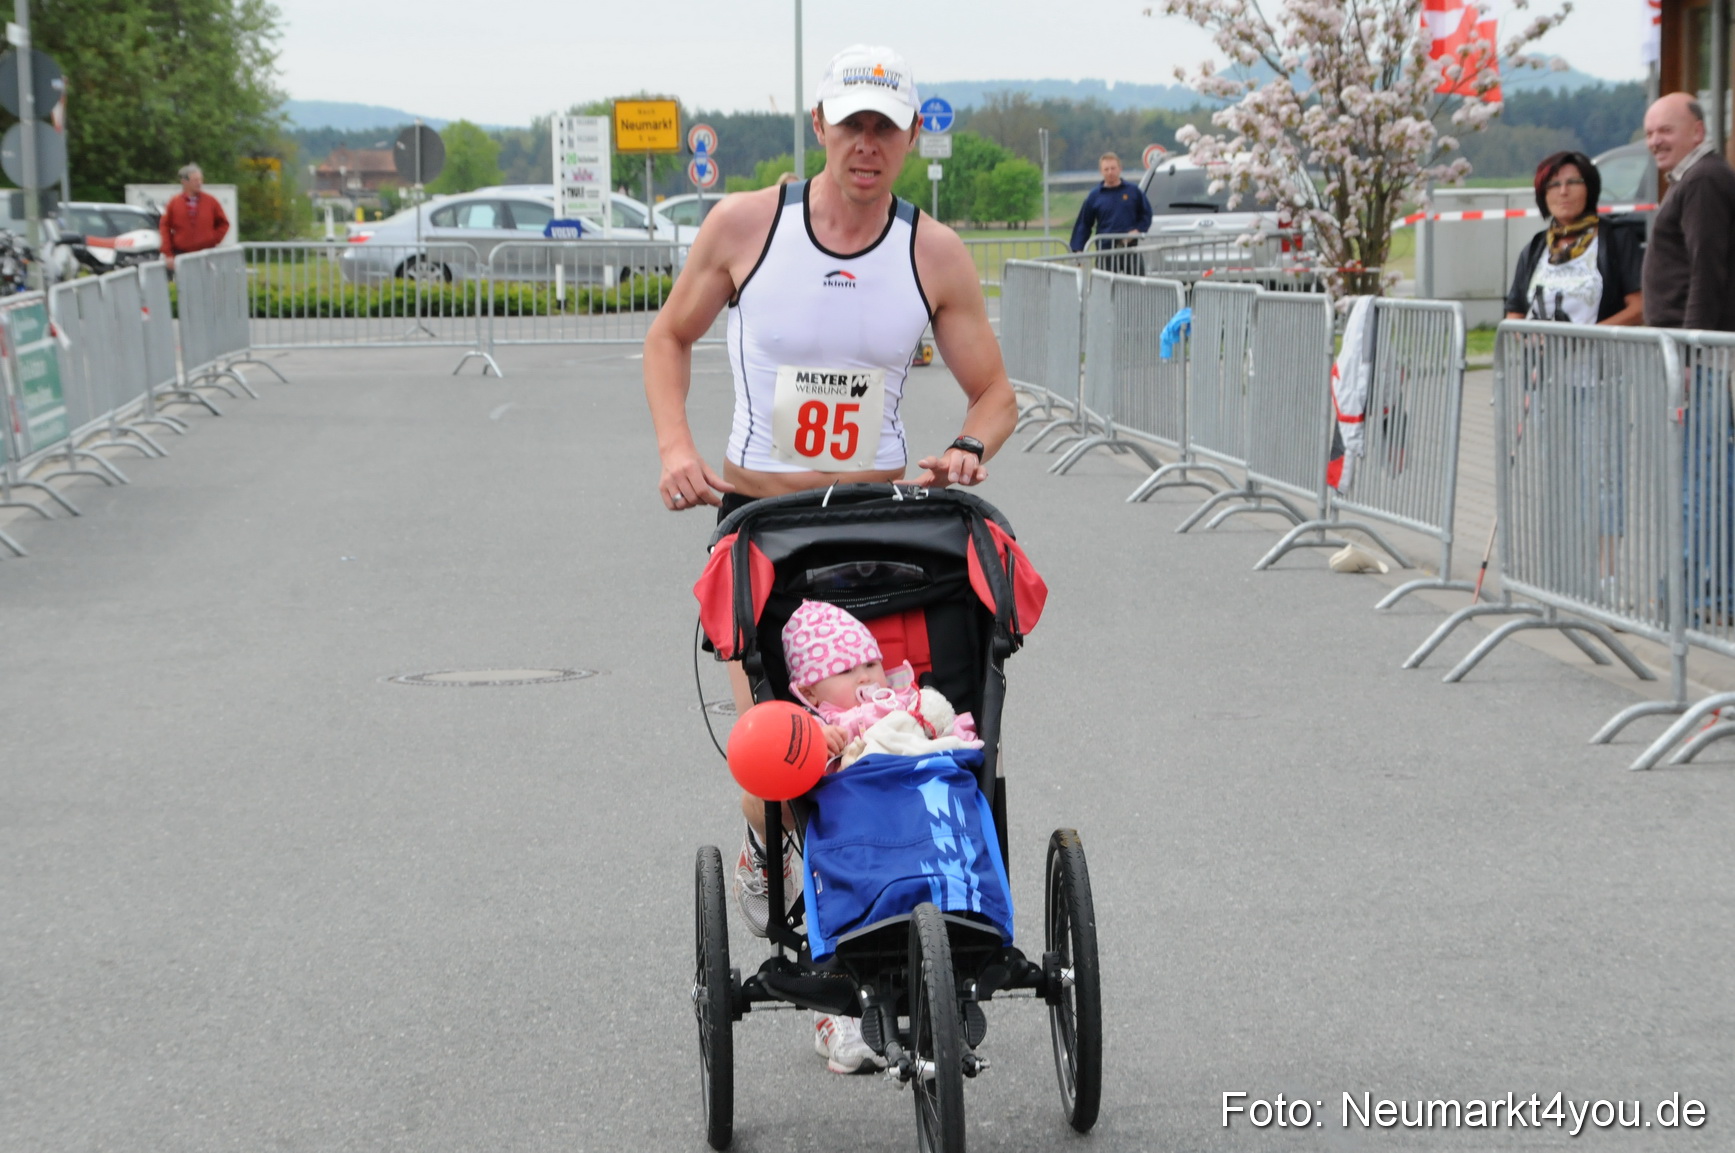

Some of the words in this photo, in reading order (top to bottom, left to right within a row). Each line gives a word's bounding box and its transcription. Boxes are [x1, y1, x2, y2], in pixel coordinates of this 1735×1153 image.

[621, 118, 672, 131] Neumarkt
[551, 226, 578, 239] VOLVO
[823, 279, 856, 288] skinfit
[796, 371, 848, 386] MEYER
[795, 383, 848, 396] WERBUNG
[794, 399, 860, 461] 85
